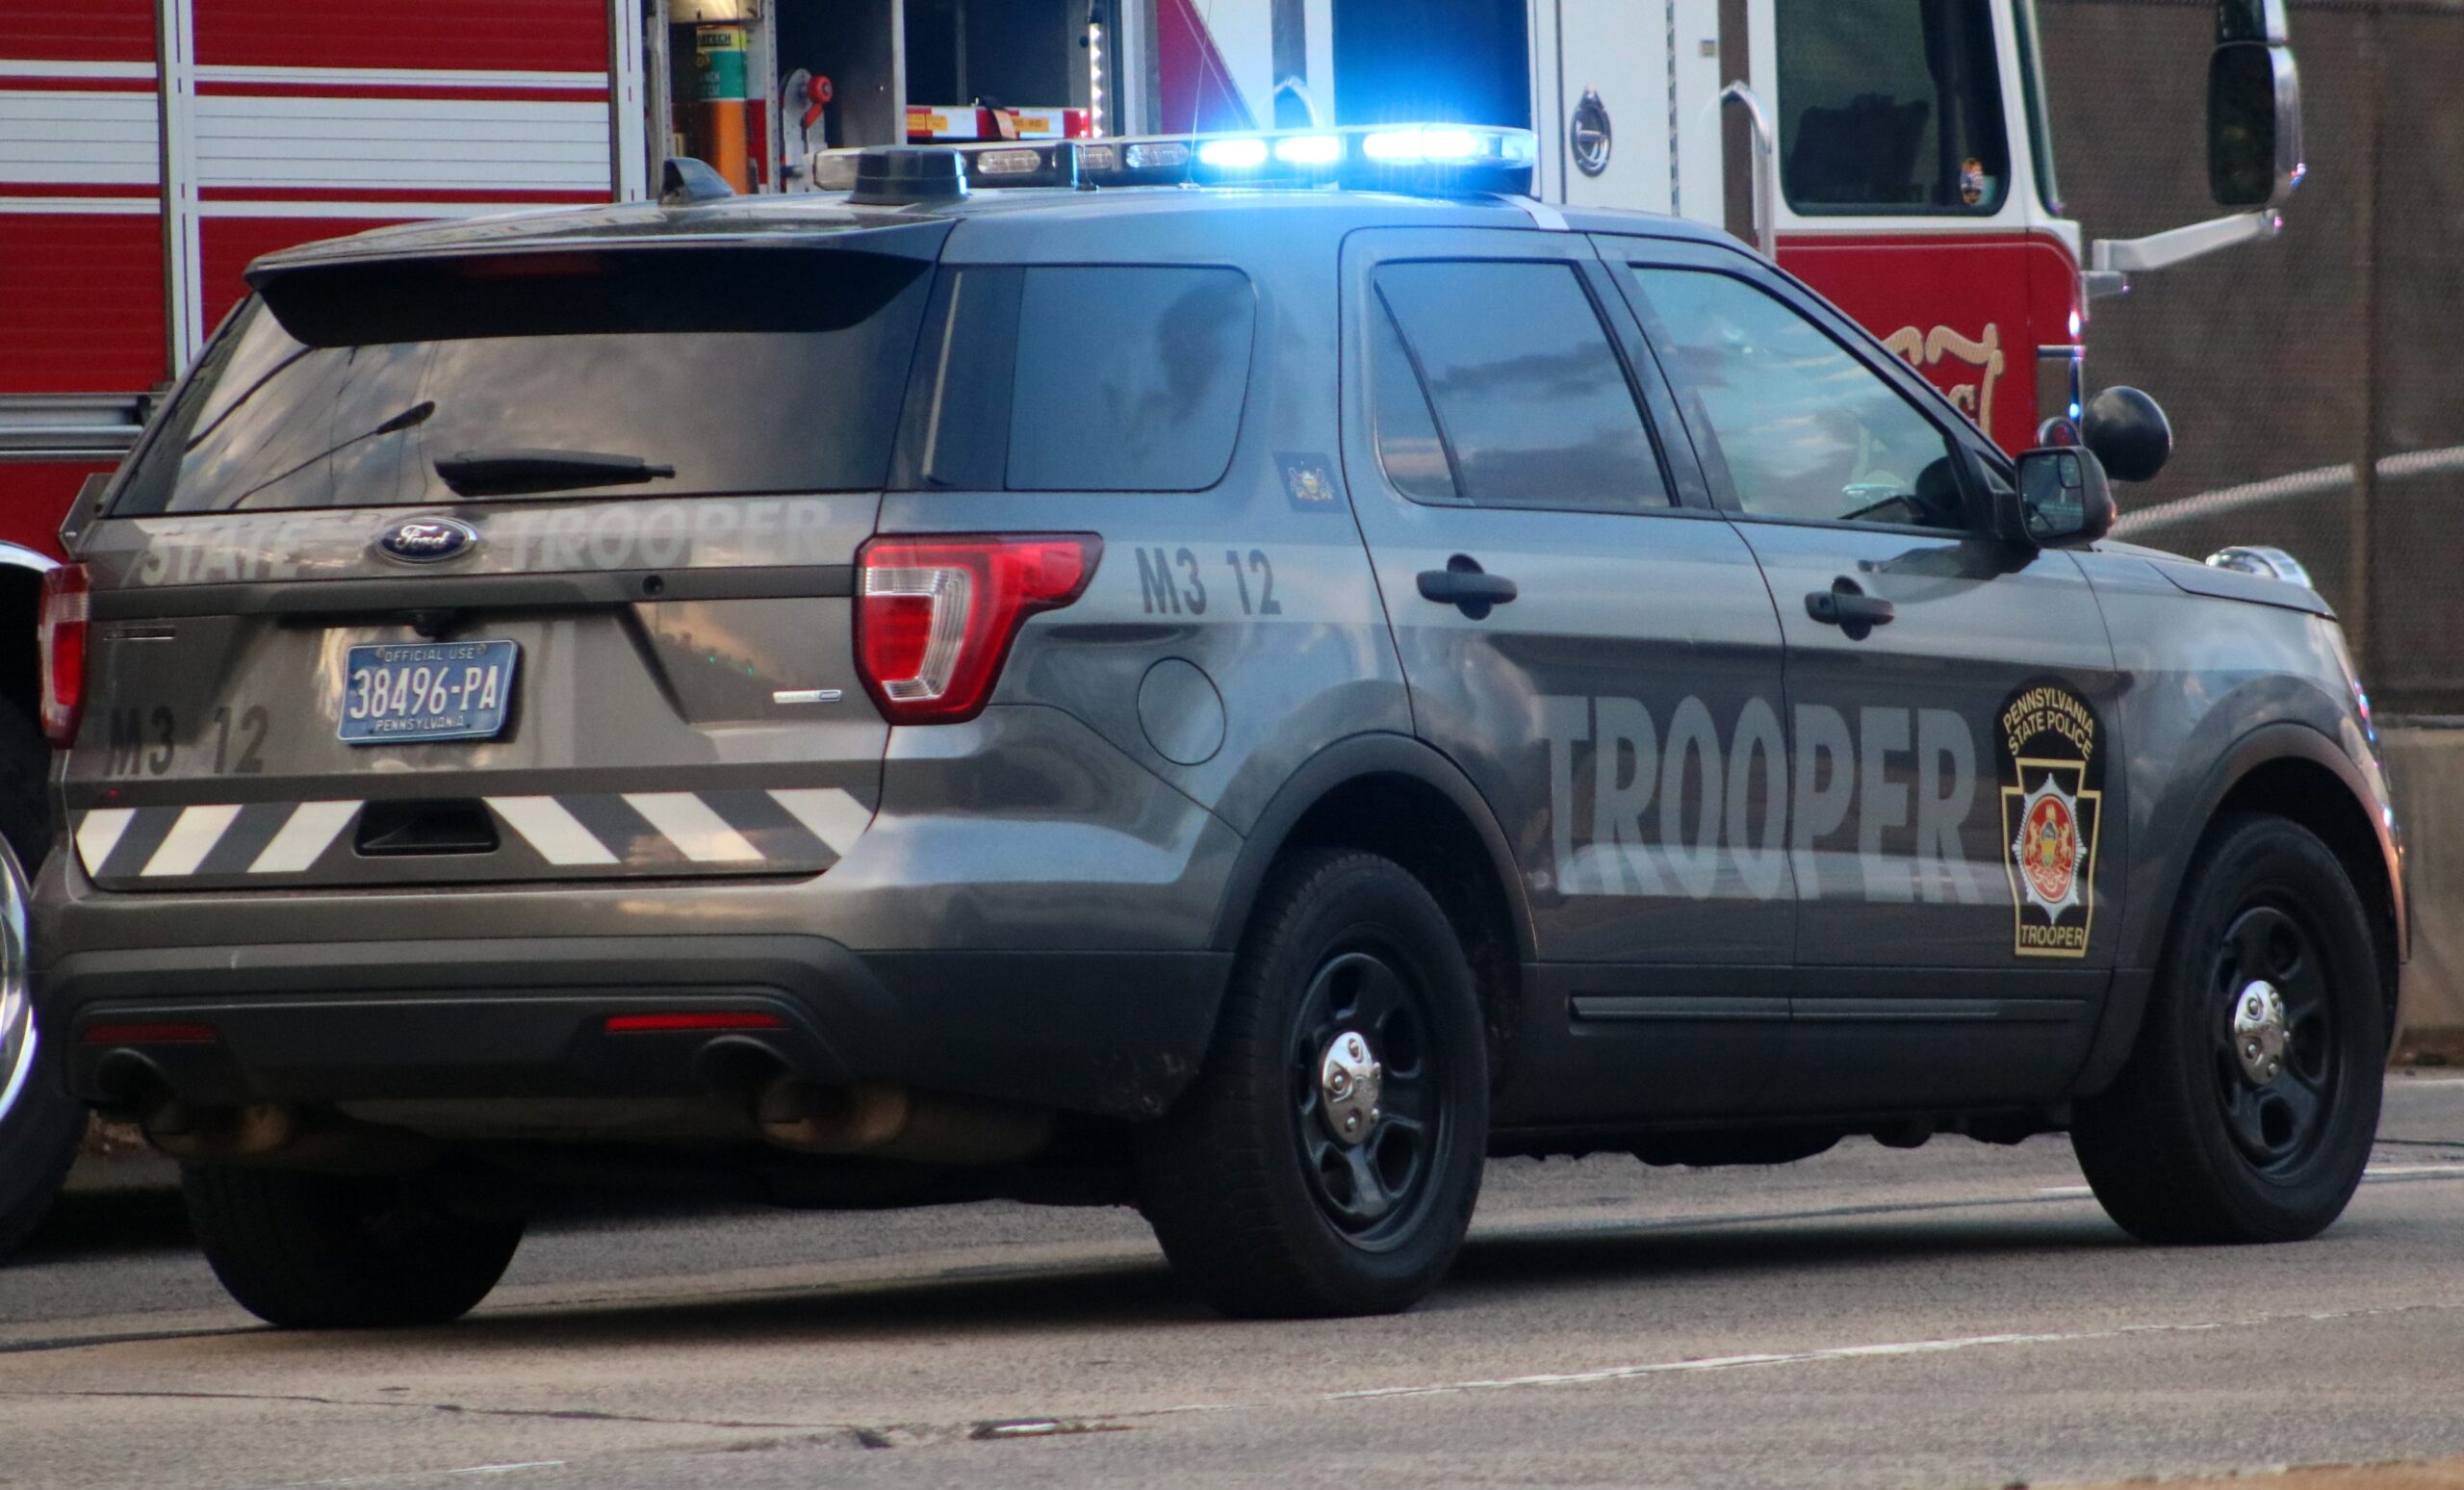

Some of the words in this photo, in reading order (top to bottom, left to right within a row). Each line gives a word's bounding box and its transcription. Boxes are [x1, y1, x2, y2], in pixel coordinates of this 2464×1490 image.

[141, 521, 309, 585] STATE
[488, 500, 836, 571] TROOPER
[394, 524, 450, 549] Ford
[1135, 546, 1207, 615] M3
[1225, 548, 1282, 615] 12
[385, 649, 443, 662] OFFICIAL
[449, 647, 475, 660] USE
[349, 665, 499, 719] 38496-PA
[2003, 687, 2094, 738] PENNSYLVANIA
[103, 705, 175, 776] M3
[214, 704, 270, 775] 12
[375, 715, 465, 732] PENNSYLVANIA
[2008, 711, 2046, 757] STATE
[2046, 710, 2093, 760] POLICE
[1530, 694, 1982, 904] TROOPER
[2021, 924, 2085, 947] TROOPER
